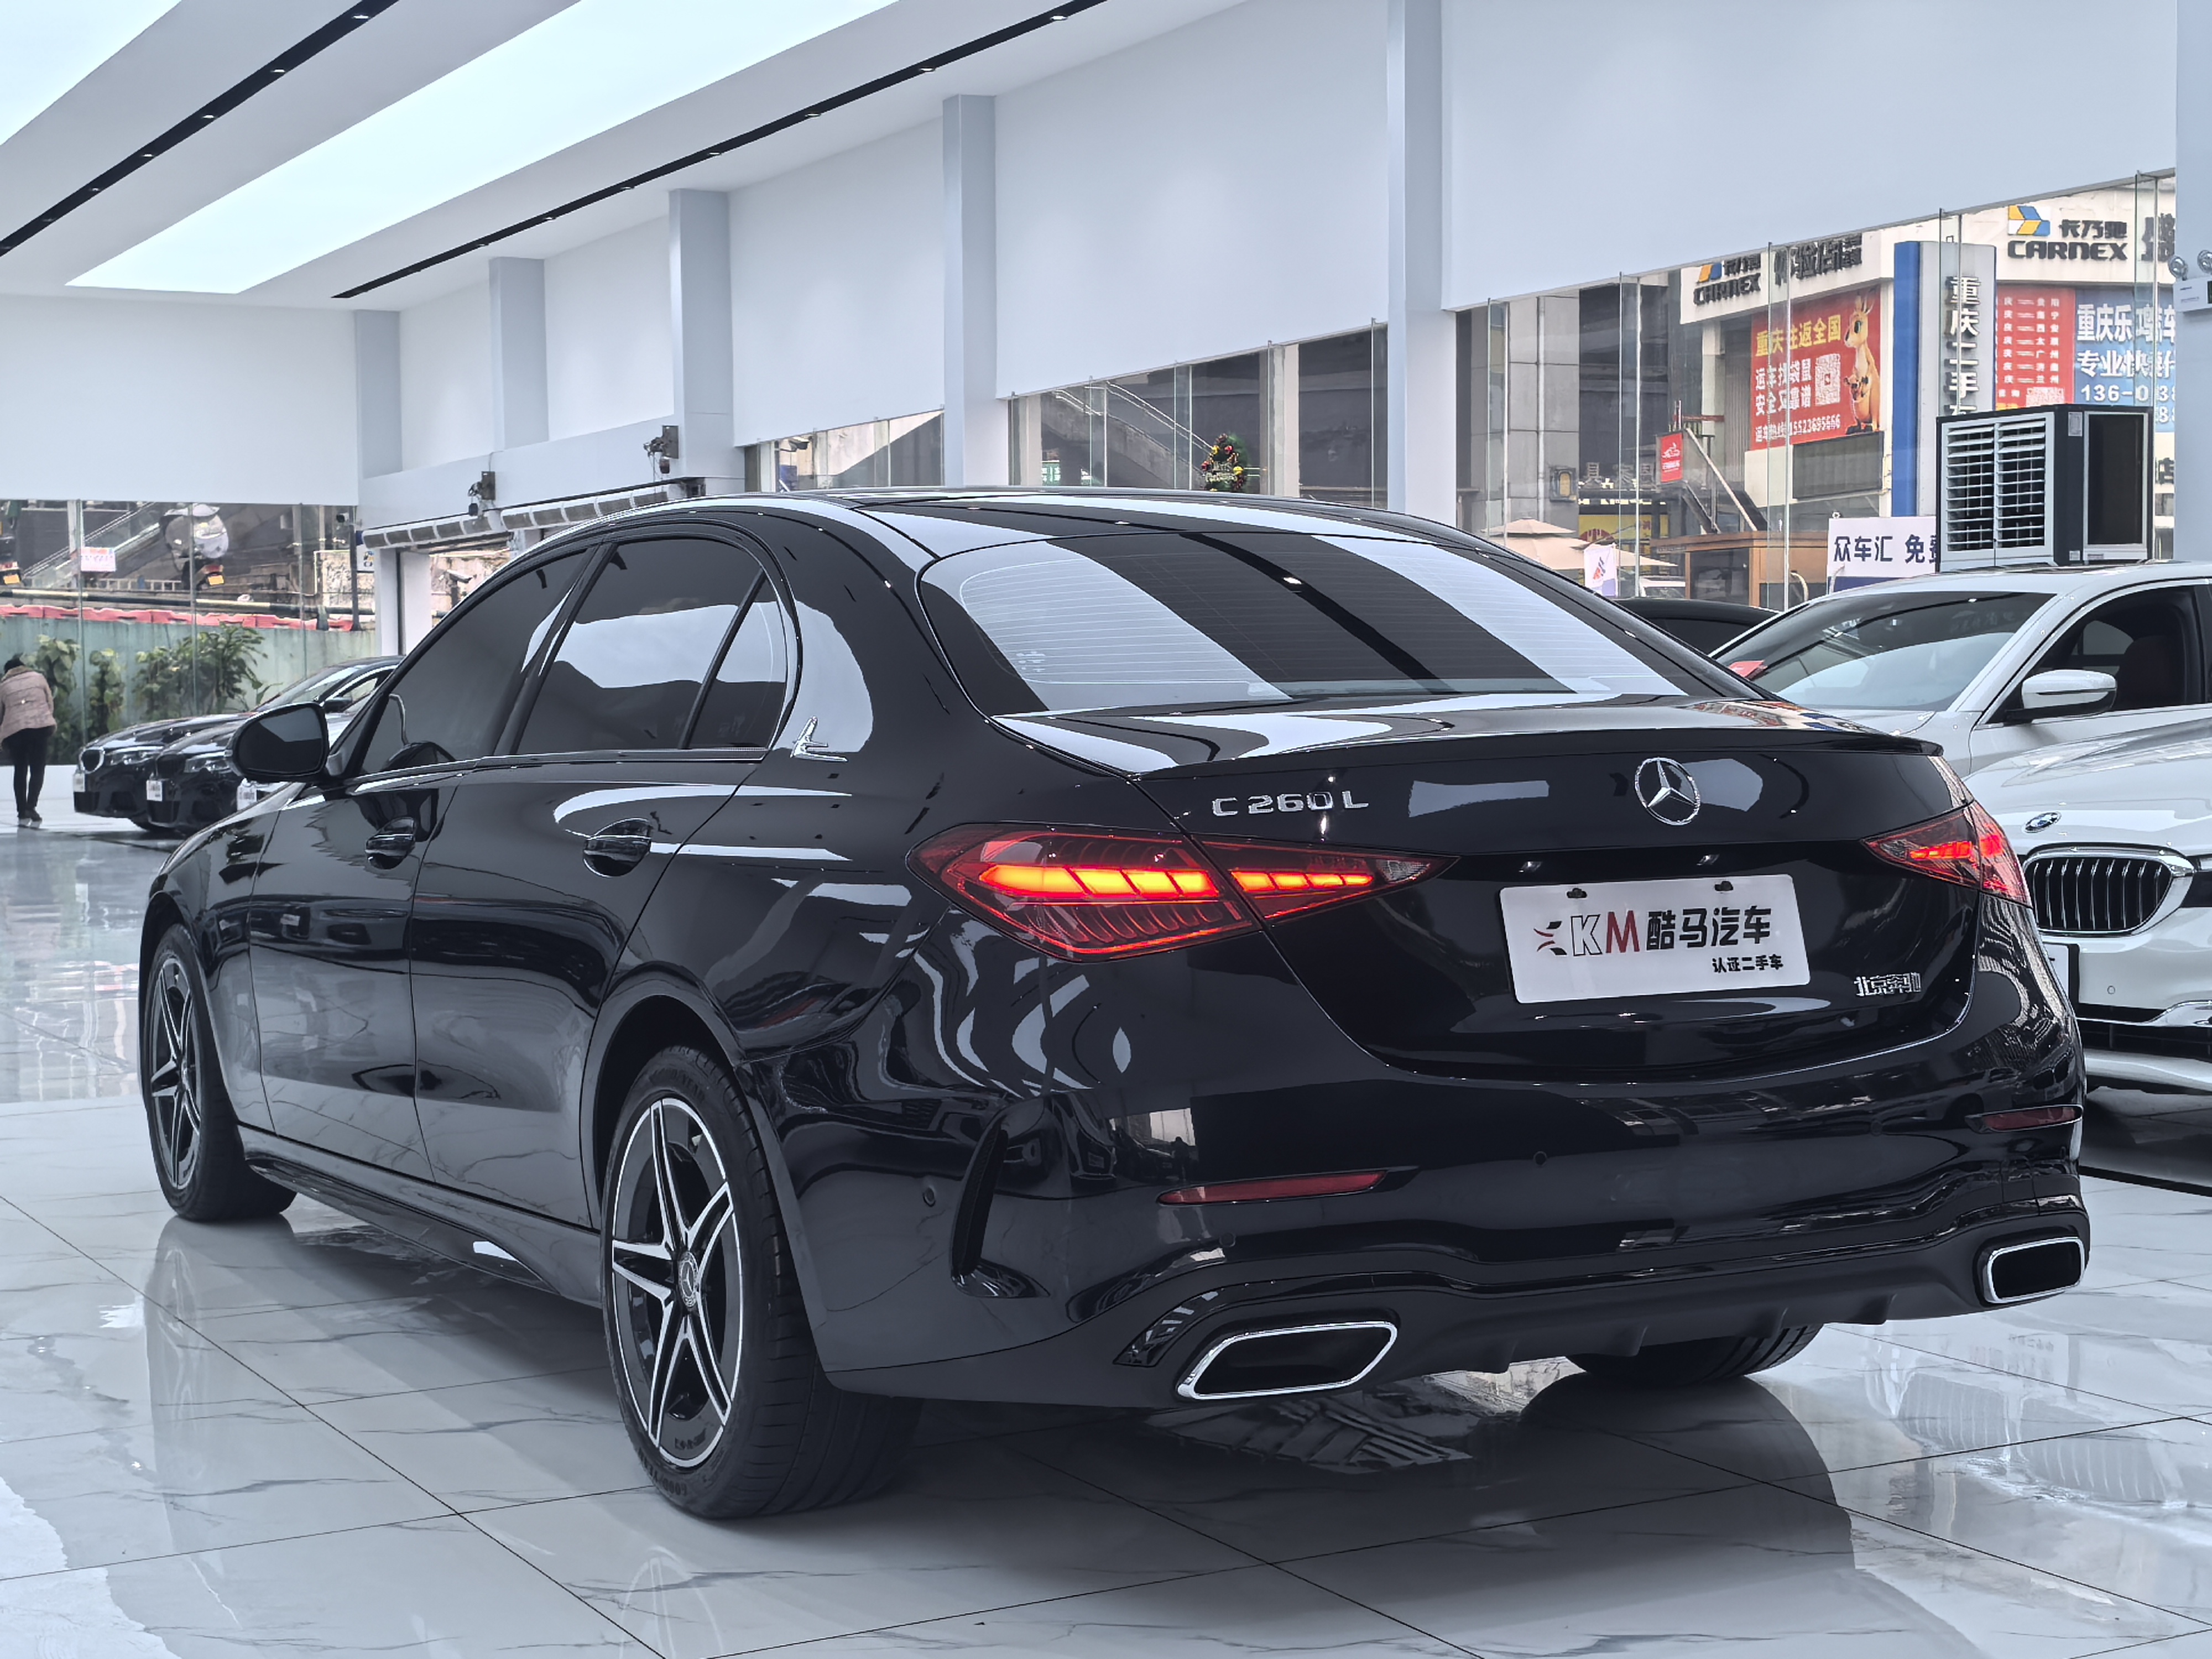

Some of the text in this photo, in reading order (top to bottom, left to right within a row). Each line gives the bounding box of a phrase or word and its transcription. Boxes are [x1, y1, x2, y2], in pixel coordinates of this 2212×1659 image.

[1949, 277, 1981, 415] 重庆二手
[1833, 536, 1893, 562] 众车汇
[1212, 790, 1369, 816] C 260 L
[1712, 954, 1783, 973] 认证二手车
[1854, 972, 1921, 996] 北京奔驰
